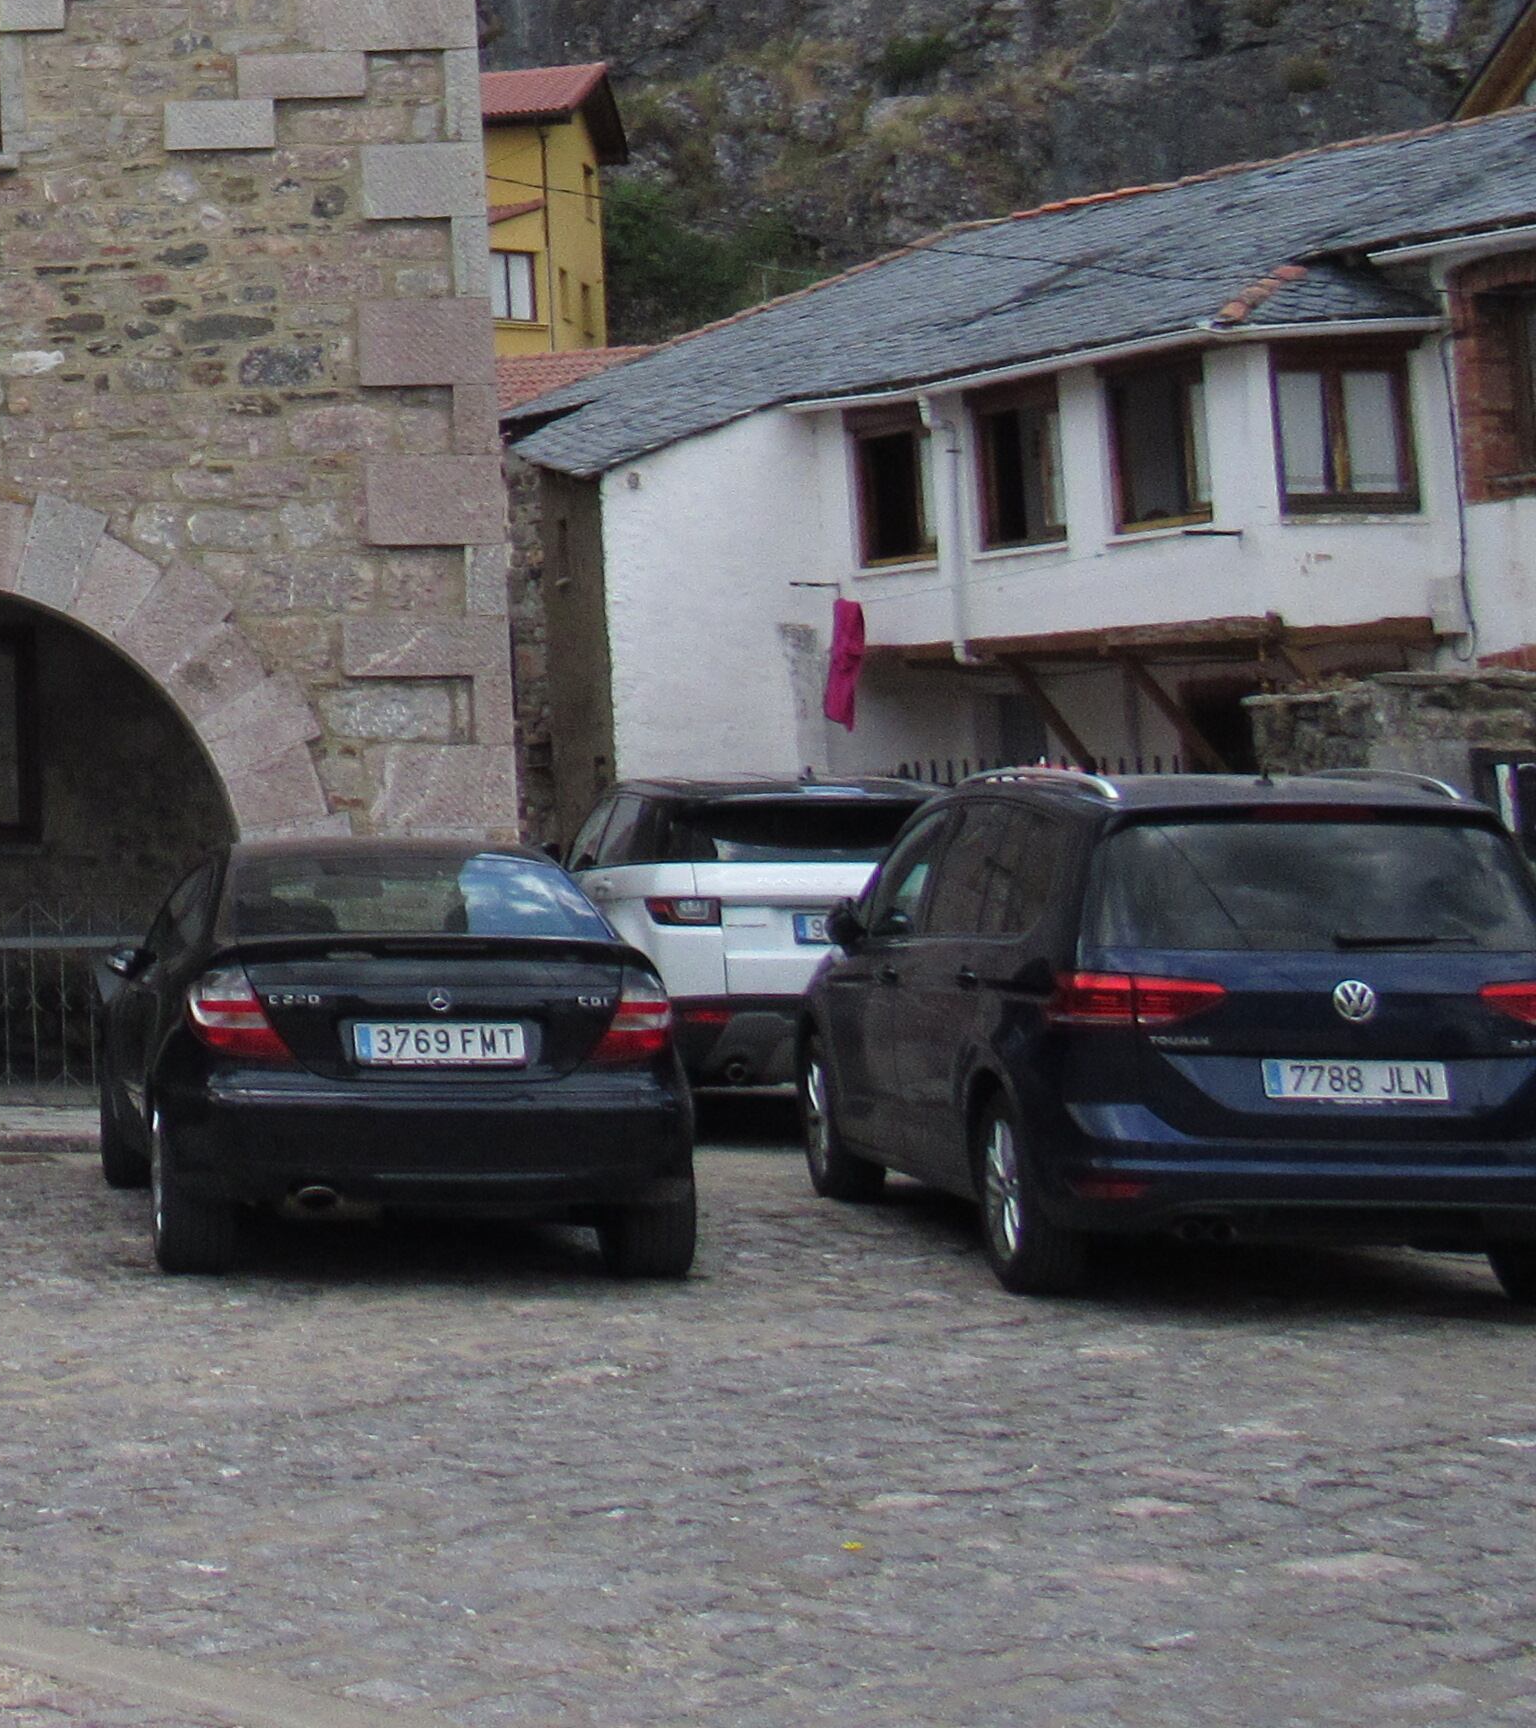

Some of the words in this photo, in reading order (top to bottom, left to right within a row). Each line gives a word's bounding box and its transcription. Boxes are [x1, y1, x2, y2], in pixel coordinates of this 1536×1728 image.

[377, 1028, 451, 1056] 3769
[461, 1028, 514, 1057] FMT
[1289, 1065, 1365, 1093] 7788
[1382, 1066, 1434, 1095] JLN
